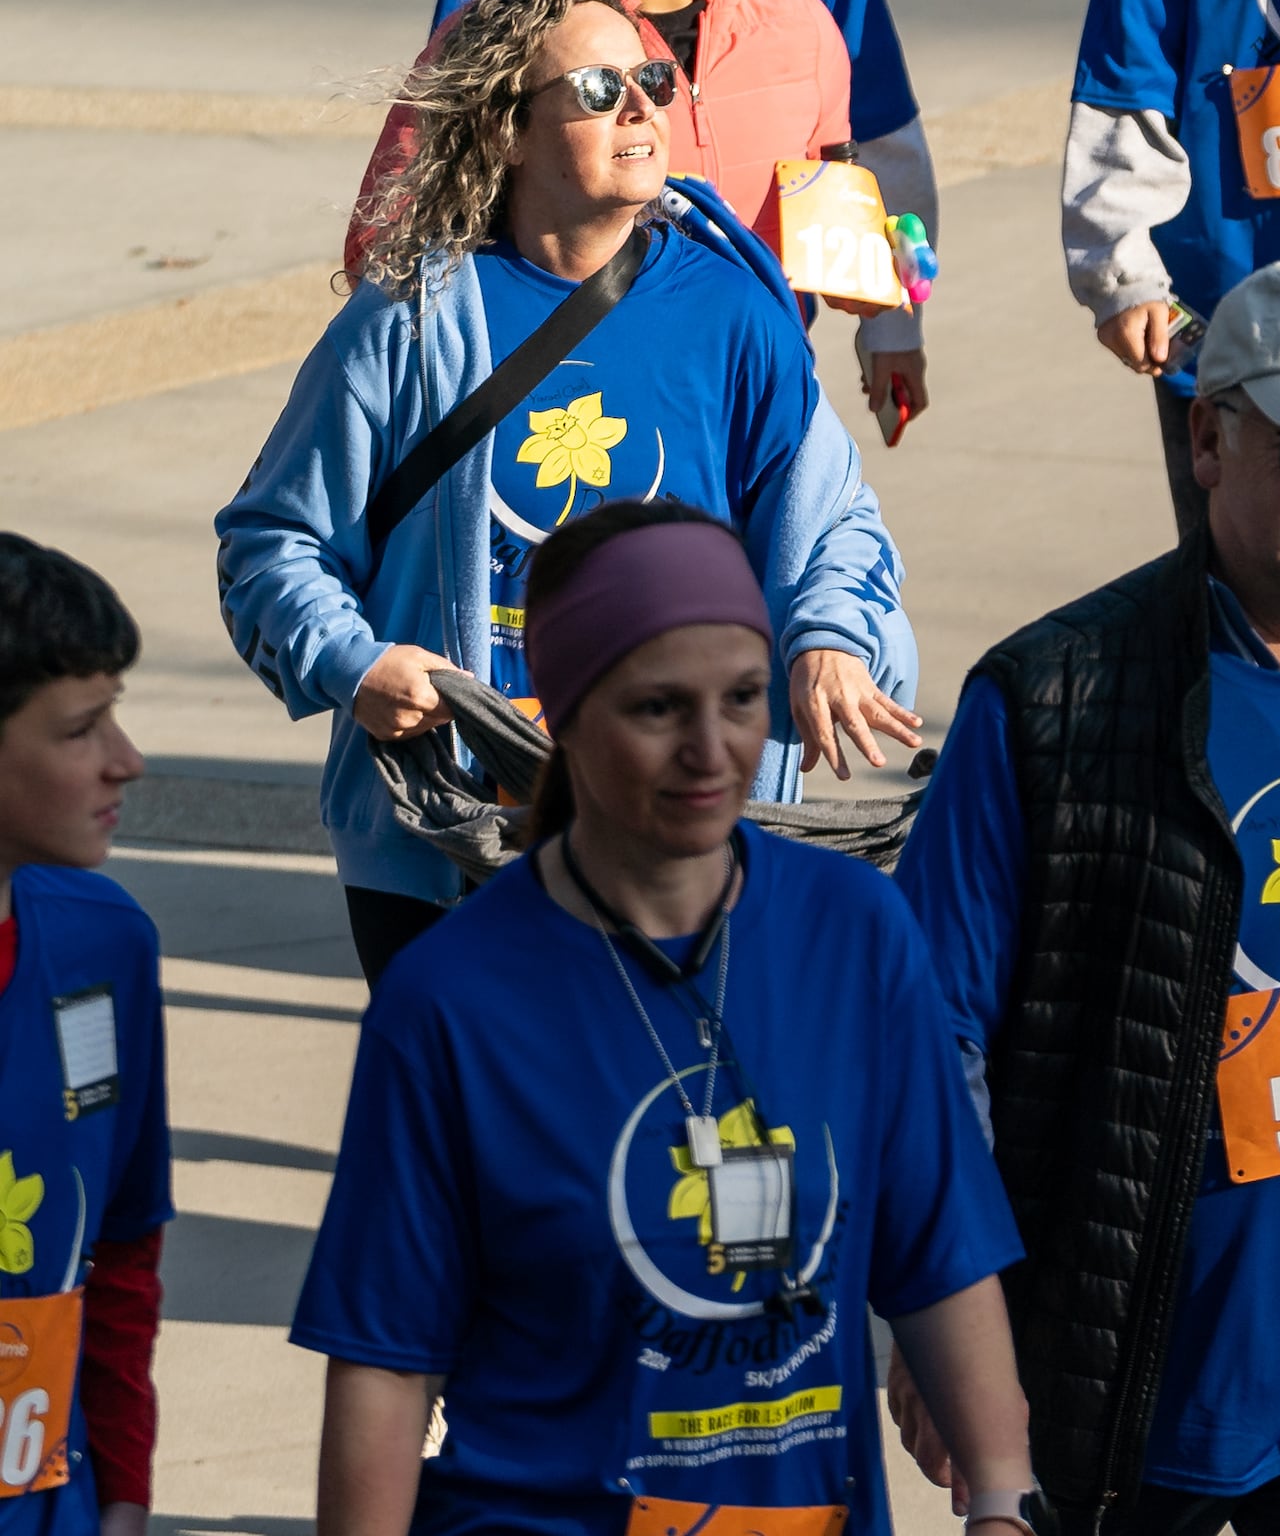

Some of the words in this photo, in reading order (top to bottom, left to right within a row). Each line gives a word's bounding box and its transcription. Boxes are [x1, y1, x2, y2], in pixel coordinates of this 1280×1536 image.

[490, 557, 504, 574] 24
[490, 635, 517, 648] PORTING
[679, 1417, 703, 1434] THE
[708, 1413, 734, 1431] RACE
[737, 1409, 760, 1425] FOR
[765, 1407, 782, 1423] 1.5
[0, 1388, 50, 1486] 6
